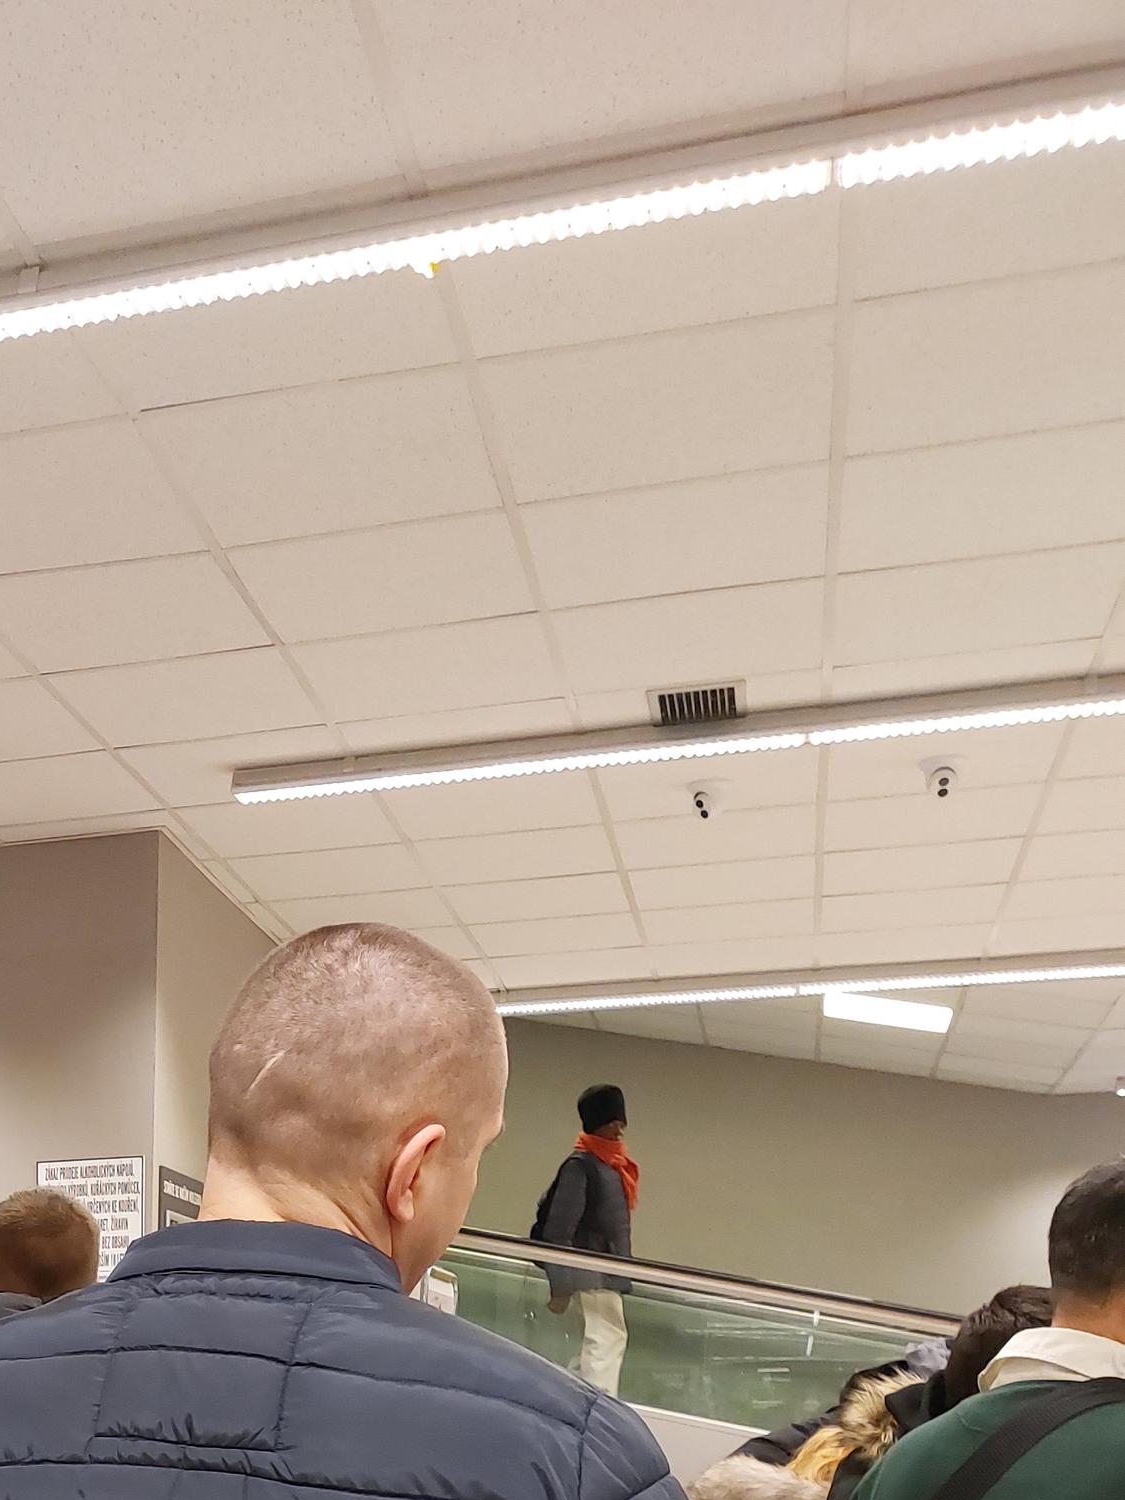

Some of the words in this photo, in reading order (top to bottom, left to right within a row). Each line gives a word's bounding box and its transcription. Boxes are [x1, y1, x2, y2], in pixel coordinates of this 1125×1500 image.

[45, 1164, 59, 1181] ZÁKAZ
[59, 1165, 79, 1180] PRODEJE
[80, 1162, 116, 1179] ALKOHOLICKÝCH
[101, 1236, 111, 1250] BEZ
